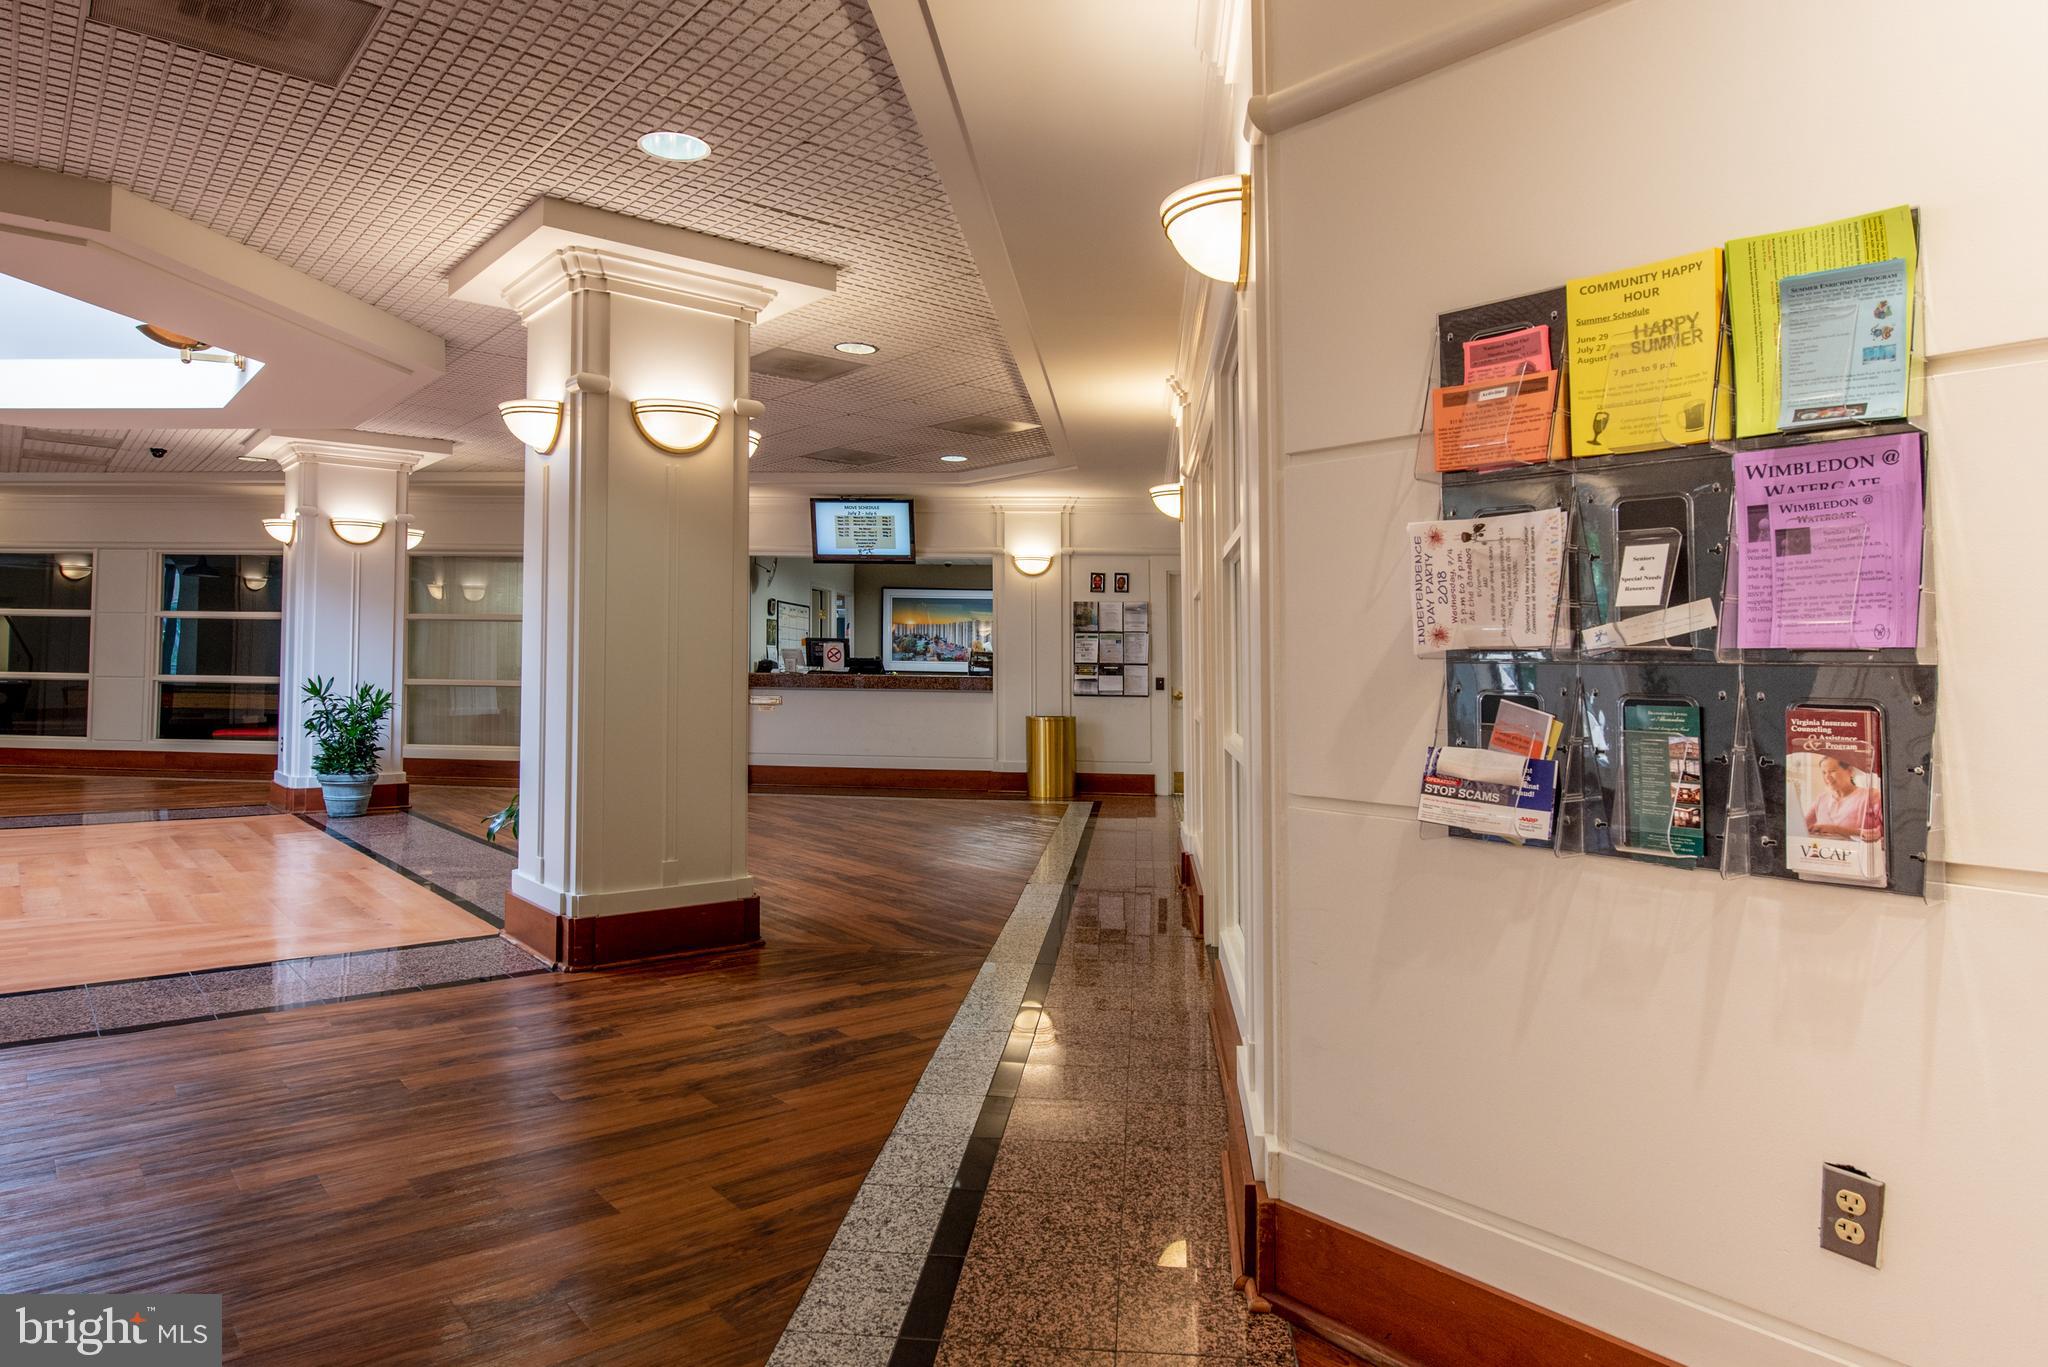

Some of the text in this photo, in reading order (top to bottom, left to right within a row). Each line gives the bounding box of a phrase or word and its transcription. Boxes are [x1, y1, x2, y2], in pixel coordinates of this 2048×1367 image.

[1580, 261, 1703, 295] COMMUNITY HAPPY
[1791, 274, 1897, 293] SUMMER ENRICHMENT PROGRAM
[1624, 288, 1660, 302] HOUR
[1576, 307, 1650, 326] Summer Schedule
[1634, 312, 1699, 339] HAPPY
[1577, 336, 1596, 344] June
[1631, 328, 1703, 354] SUMMER
[1577, 346, 1593, 354] July
[1577, 354, 1607, 364] August
[1621, 367, 1640, 377] p.m.
[1745, 449, 1900, 480] WIMBLEDON @
[1779, 495, 1873, 514] WIMBLEDON @
[1414, 536, 1426, 645] INDEPENDENCE
[1424, 552, 1435, 625] DAY PARTY
[1437, 570, 1448, 604] 2018
[1449, 569, 1458, 624] Wednesday,
[1458, 583, 1465, 594] to
[1791, 725, 1832, 734] Counseling
[1803, 734, 1821, 751] &
[1825, 742, 1857, 750] Program
[1425, 784, 1456, 796] STOP
[1458, 788, 1500, 803] SCAMS
